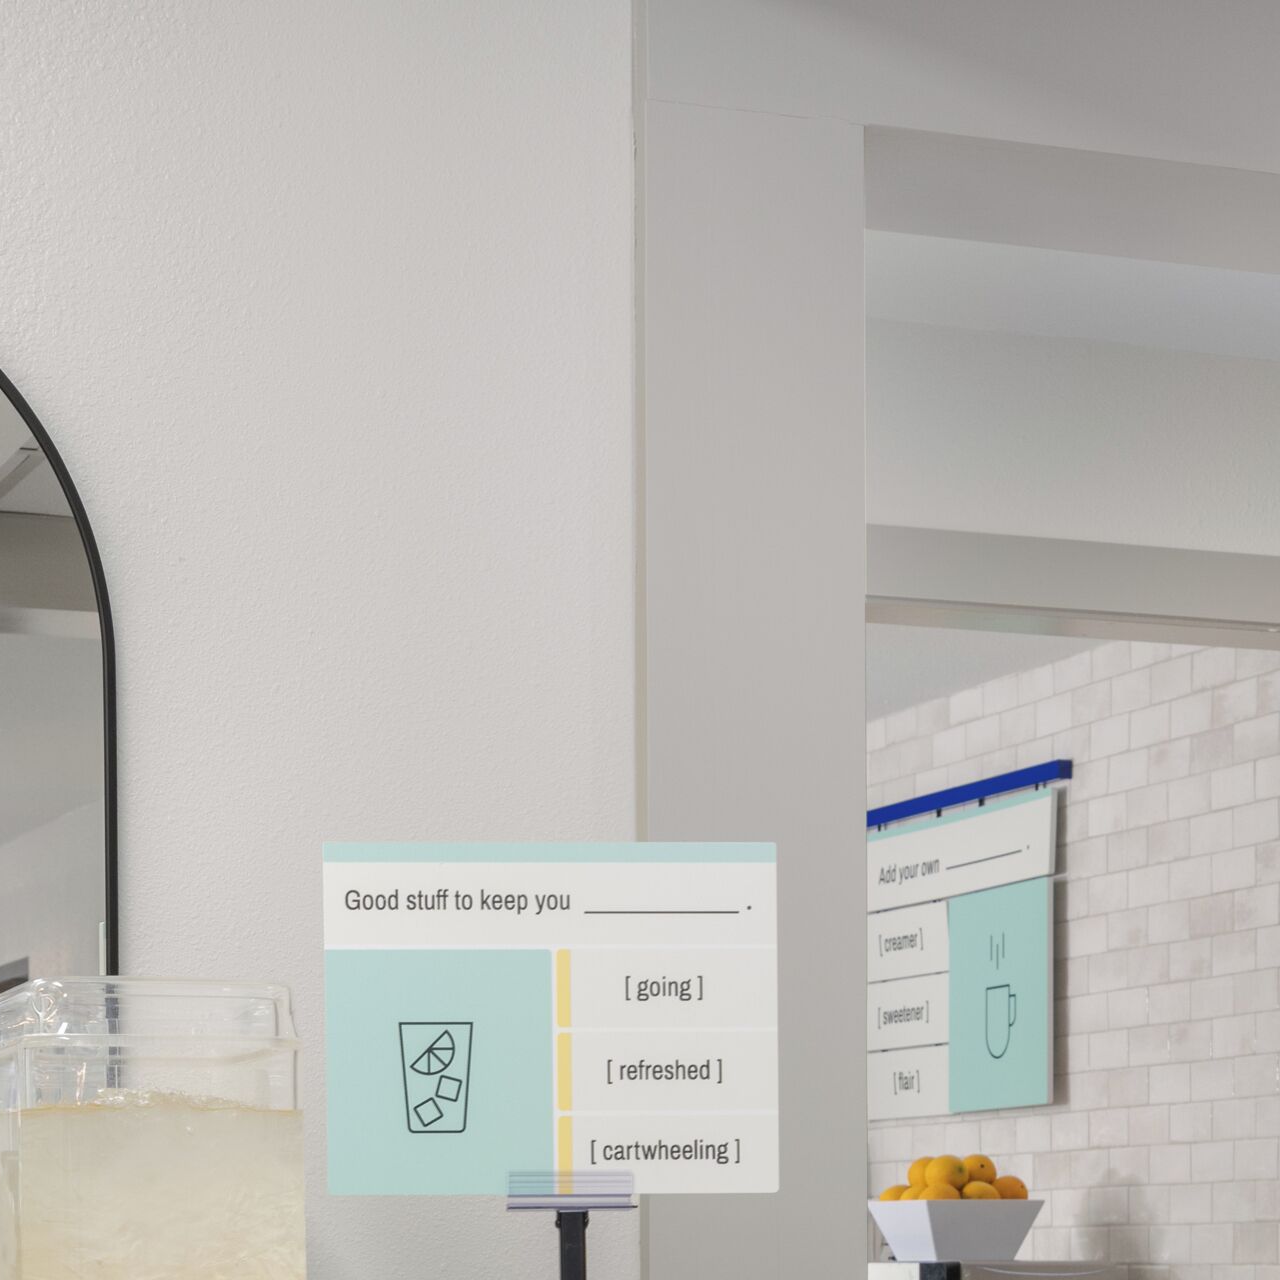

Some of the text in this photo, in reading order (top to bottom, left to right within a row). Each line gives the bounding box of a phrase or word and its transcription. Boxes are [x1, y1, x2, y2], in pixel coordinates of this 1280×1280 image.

[878, 858, 941, 885] Add your own
[344, 888, 571, 916] Good stuff to keep you
[884, 933, 918, 952] creamer
[636, 976, 693, 1002] going
[883, 1003, 924, 1026] sweetener
[619, 1059, 711, 1081] refreshed
[898, 1070, 916, 1092] flair
[602, 1138, 730, 1165] cartwheeling
